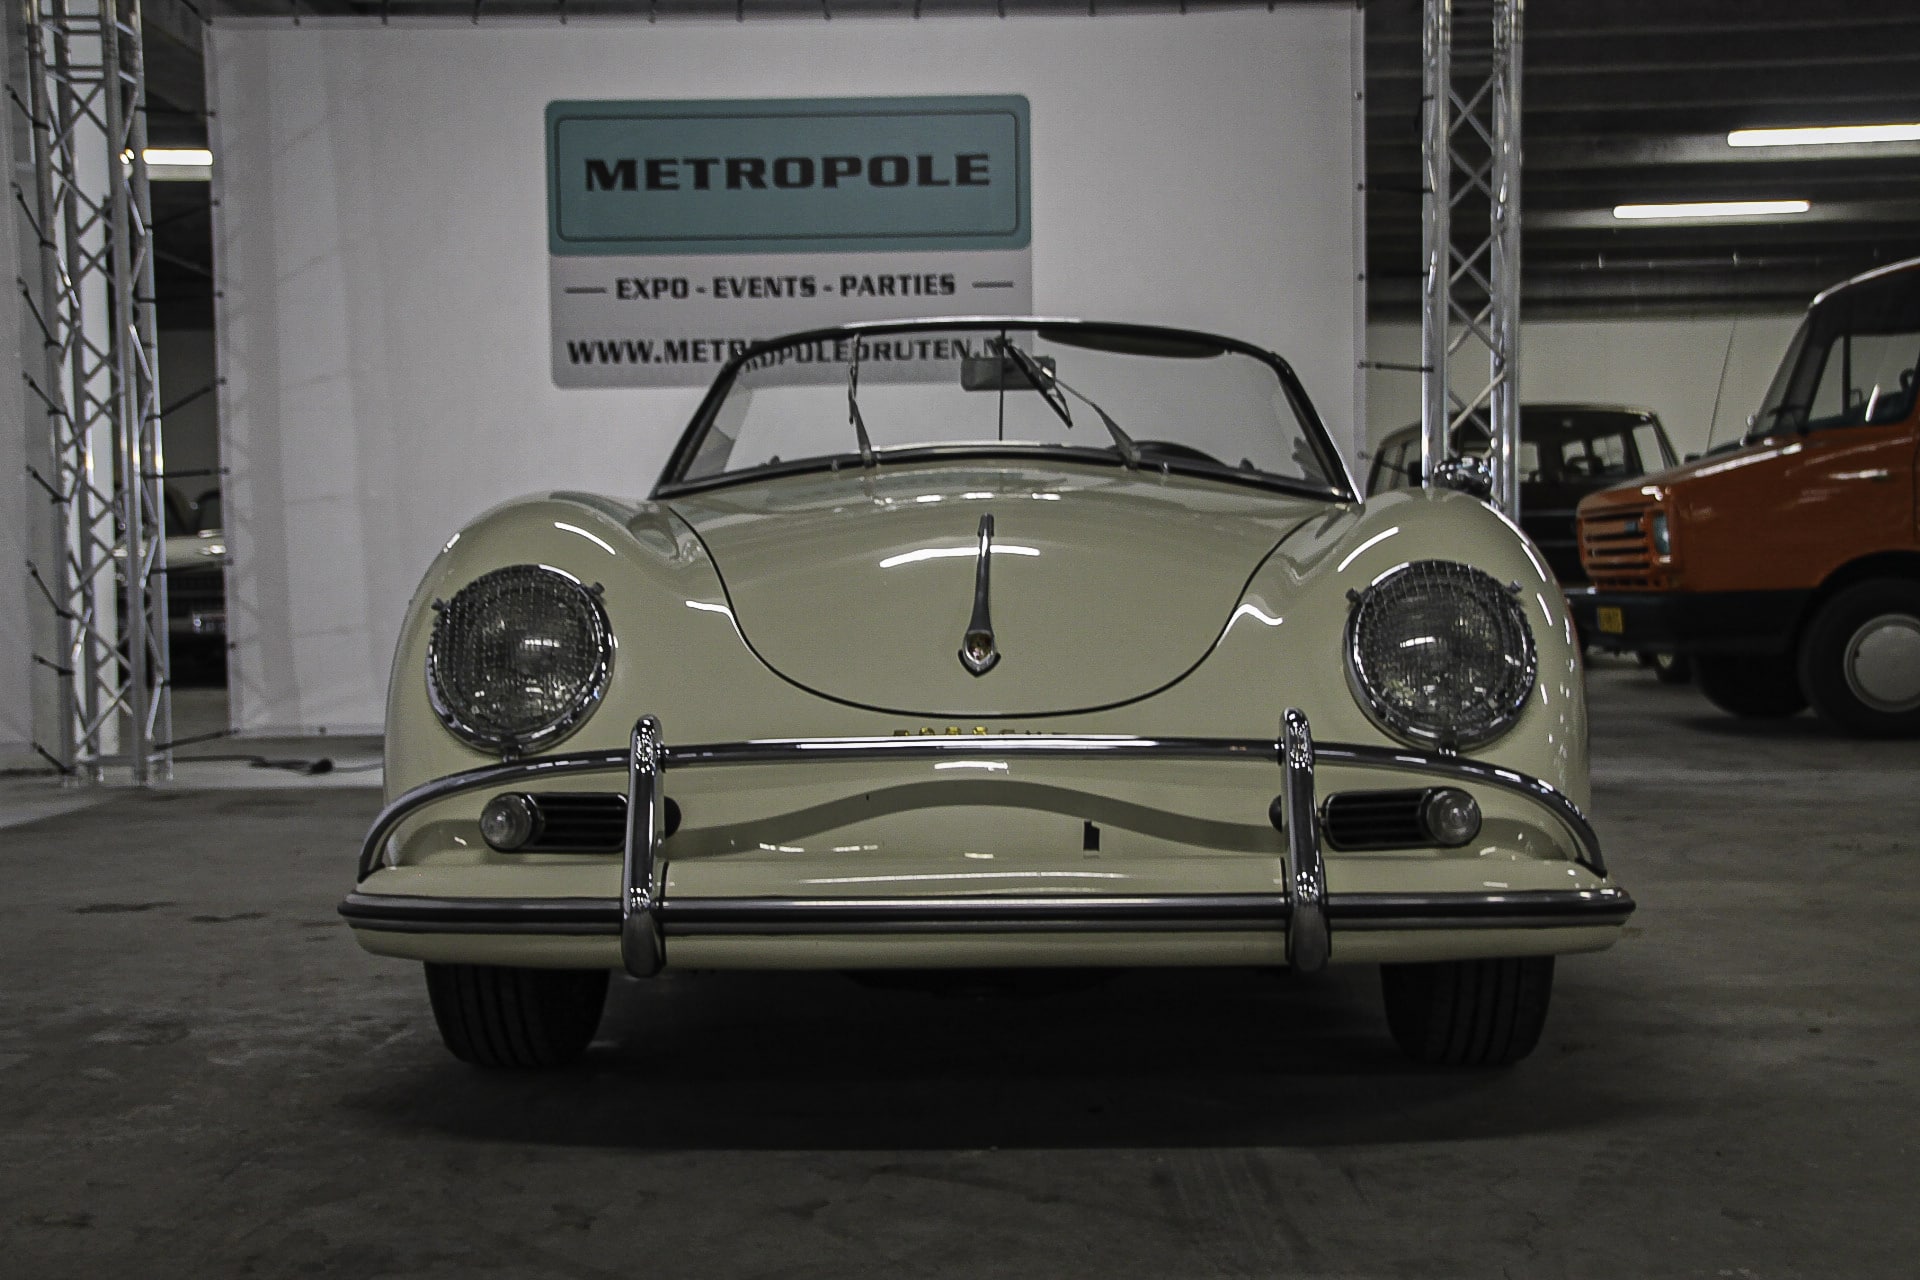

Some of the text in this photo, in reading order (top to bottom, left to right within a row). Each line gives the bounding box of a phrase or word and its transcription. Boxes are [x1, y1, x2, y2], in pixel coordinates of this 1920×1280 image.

[584, 154, 990, 192] METROPOLE
[615, 277, 689, 300] EXPO
[713, 275, 817, 299] EVENTS
[840, 273, 955, 297] PARTIES
